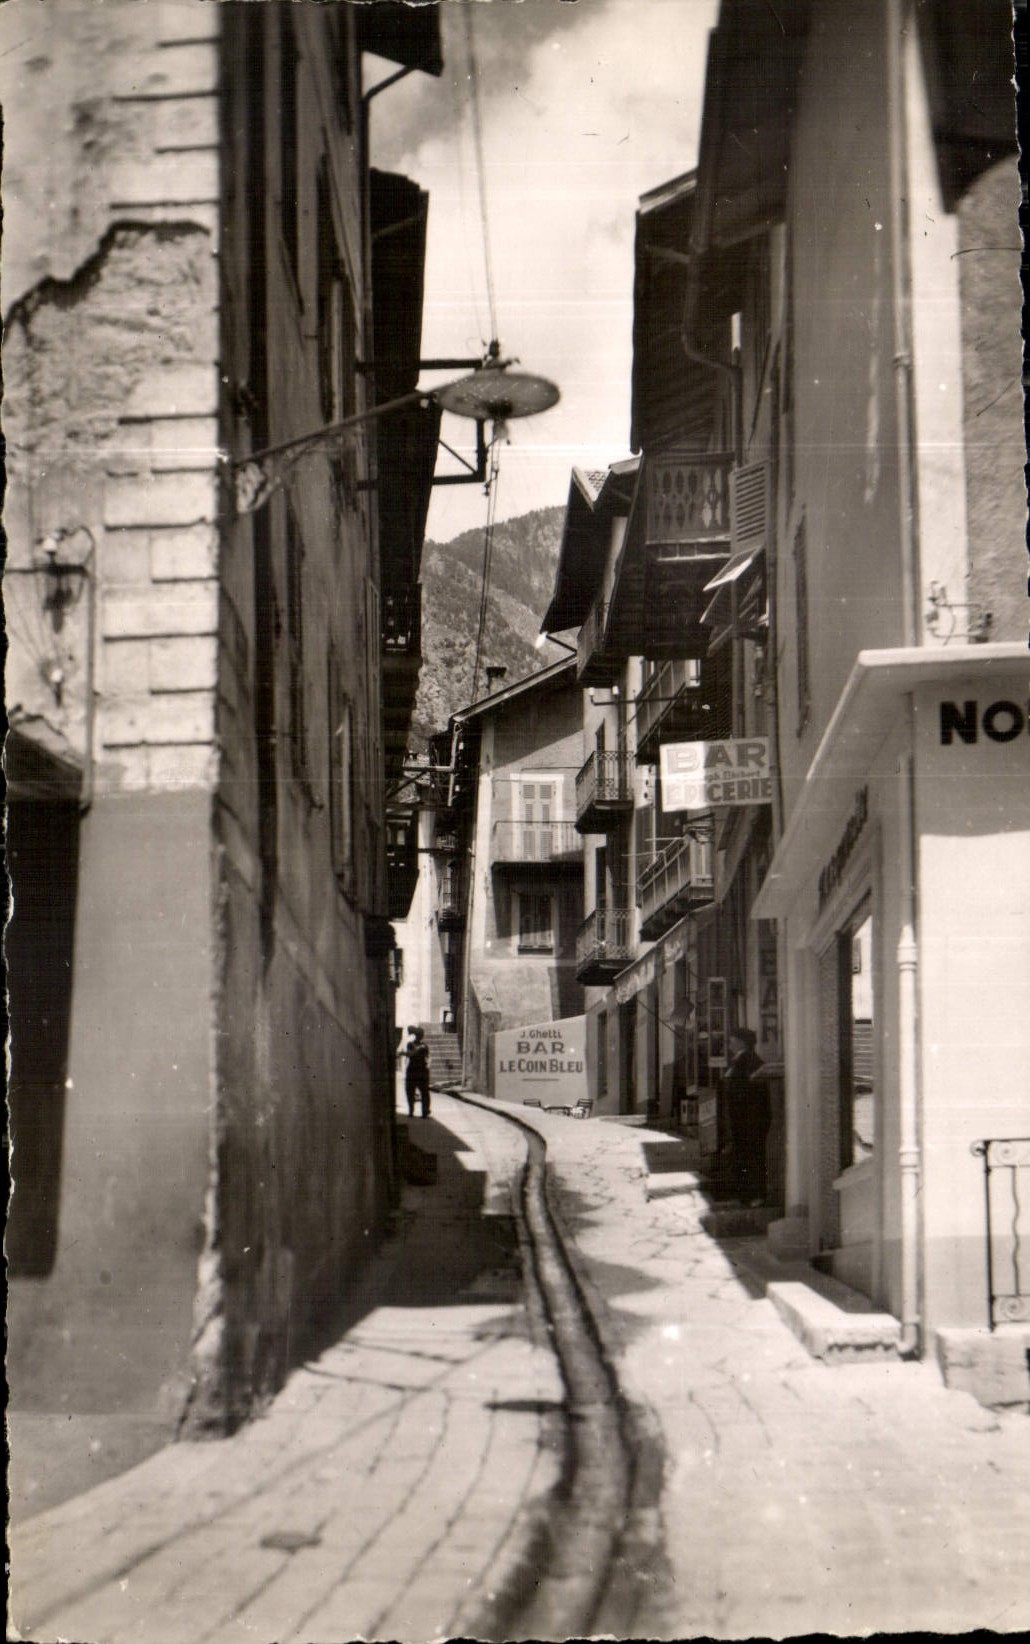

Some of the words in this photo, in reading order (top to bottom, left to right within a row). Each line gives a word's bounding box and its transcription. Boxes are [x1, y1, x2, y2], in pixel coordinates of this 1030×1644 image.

[940, 697, 1030, 746] NO
[666, 742, 766, 775] BAR
[666, 777, 773, 807] EPICERIE
[517, 1041, 565, 1054] BAR
[500, 1061, 516, 1073] LE
[518, 1059, 547, 1073] COIN
[549, 1059, 584, 1073] BLEU
